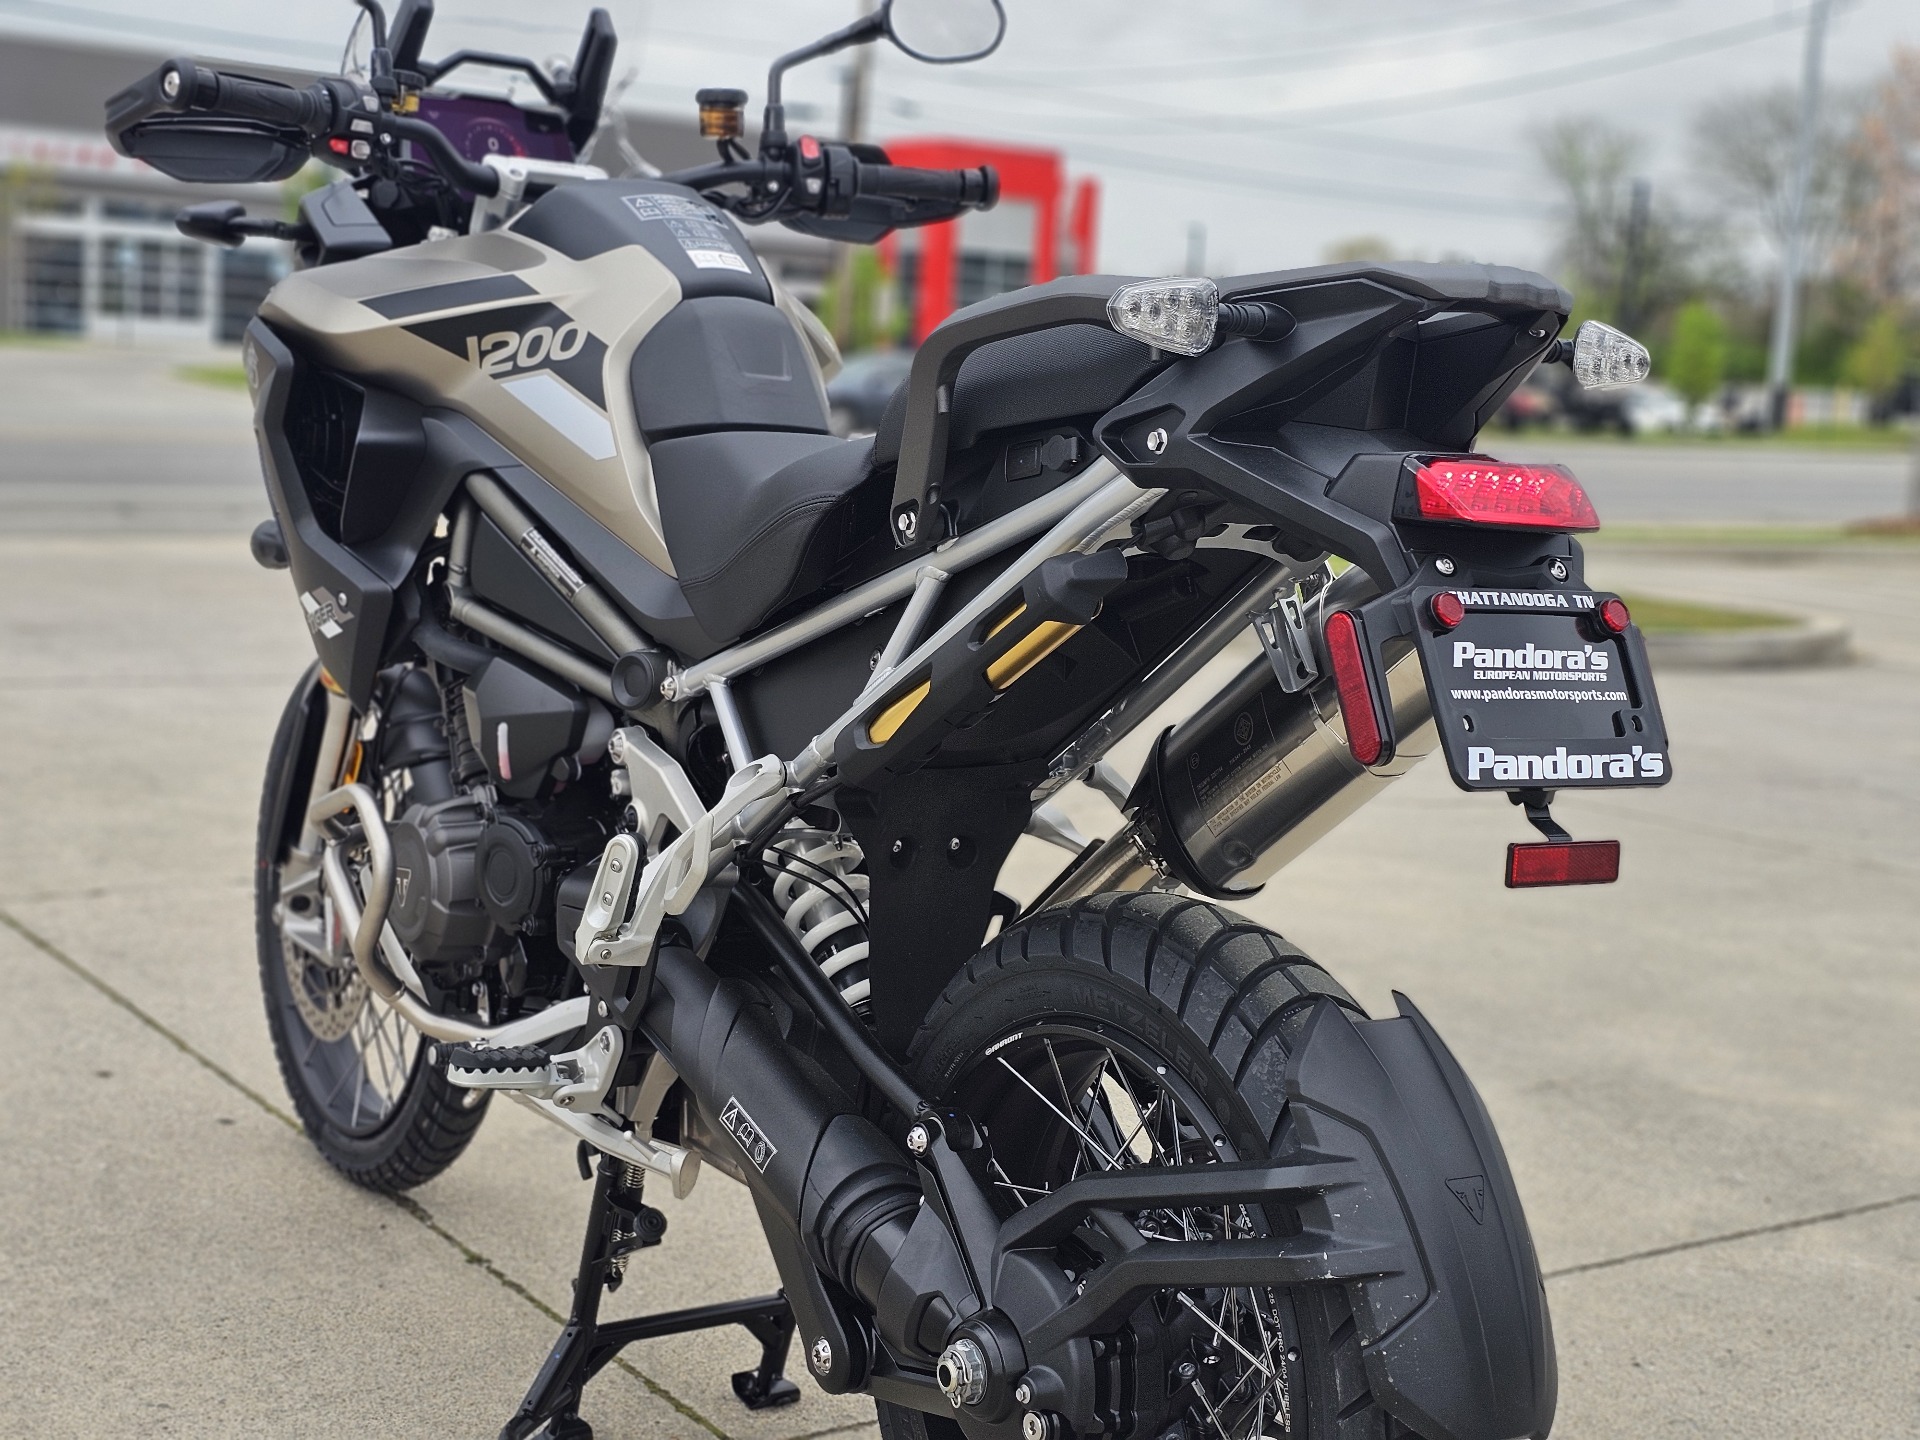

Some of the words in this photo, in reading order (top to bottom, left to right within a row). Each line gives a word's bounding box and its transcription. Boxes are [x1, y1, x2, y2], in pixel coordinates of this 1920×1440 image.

[466, 320, 588, 374] 1200
[1449, 591, 1569, 608] HATTANOOGA
[1573, 595, 1595, 608] TN
[1453, 641, 1609, 670] Pandora's
[1474, 670, 1530, 680] EUROPEAN
[1533, 671, 1607, 682] MOTORSPORTS
[1451, 687, 1627, 704] www.pandorasmotorsports.com
[1467, 745, 1664, 781] Pandora's
[1272, 1309, 1281, 1329] DOT
